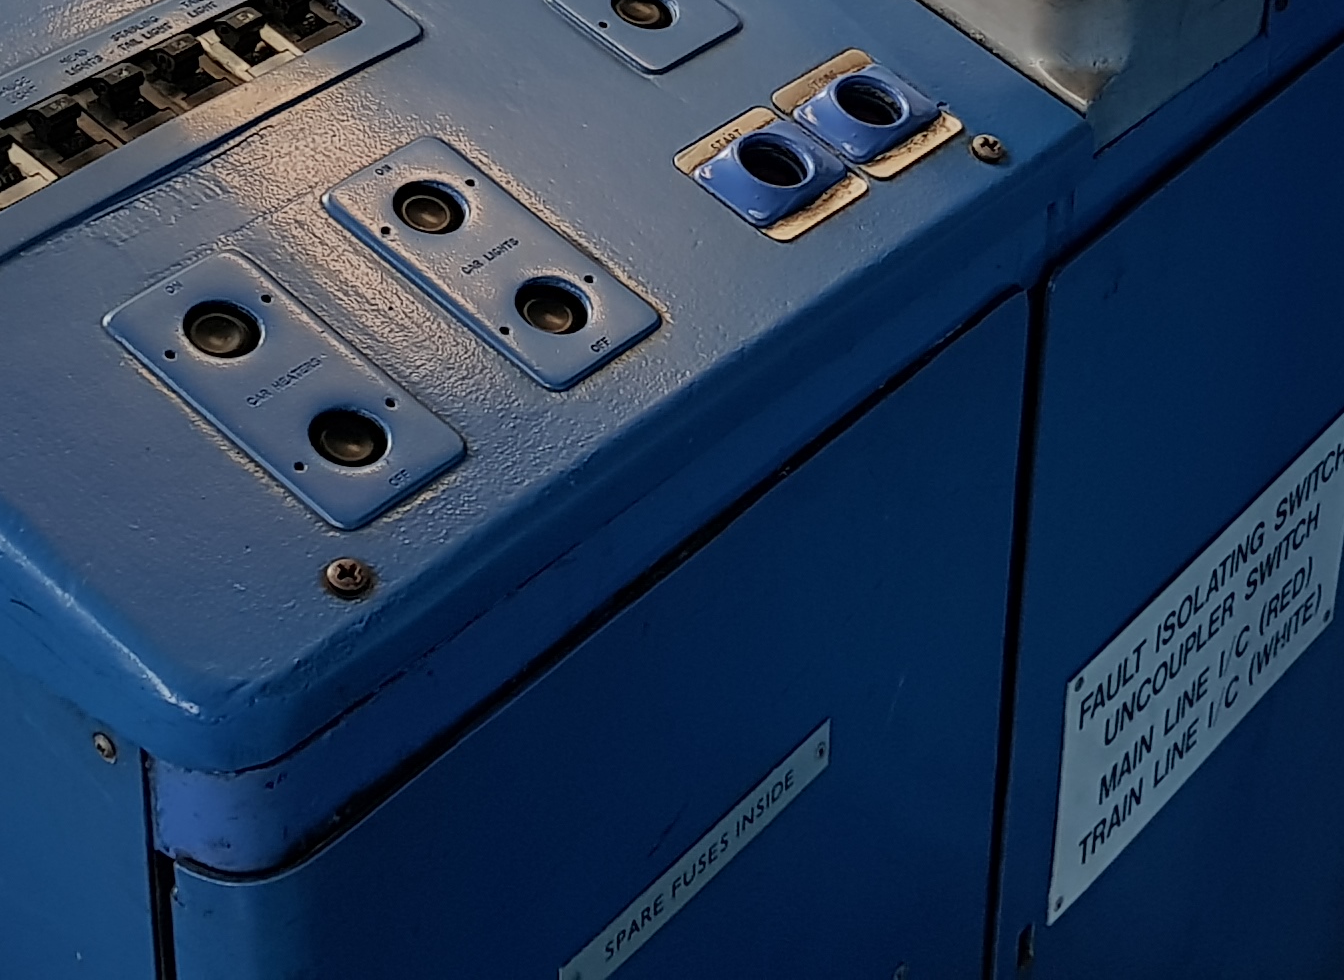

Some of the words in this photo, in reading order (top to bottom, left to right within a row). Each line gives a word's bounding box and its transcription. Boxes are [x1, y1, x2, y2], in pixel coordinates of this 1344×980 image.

[186, 1, 218, 18] LIGHT
[141, 22, 174, 41] LIGHT
[374, 163, 392, 177] ON
[482, 237, 519, 261] LIGHTS
[589, 335, 610, 353] OFF
[246, 388, 272, 407] CAR
[388, 468, 410, 487] OFF
[1077, 637, 1147, 731] FAULT
[1154, 520, 1266, 654] ISOLATING
[1103, 590, 1236, 747] UNCOUPLER
[1244, 502, 1321, 602] SWITCH
[1097, 724, 1154, 806] MAIN
[1164, 664, 1210, 736] LINE
[1218, 623, 1251, 680] I/C
[1258, 555, 1313, 638] (RED)
[1078, 776, 1143, 866] TRAIN
[1152, 719, 1198, 789] LINE
[1207, 674, 1240, 730] I/C
[1247, 583, 1323, 688] (WHITE)
[605, 893, 665, 962] SPARE
[671, 831, 729, 899] FUSES
[735, 768, 795, 838] INSIDE
